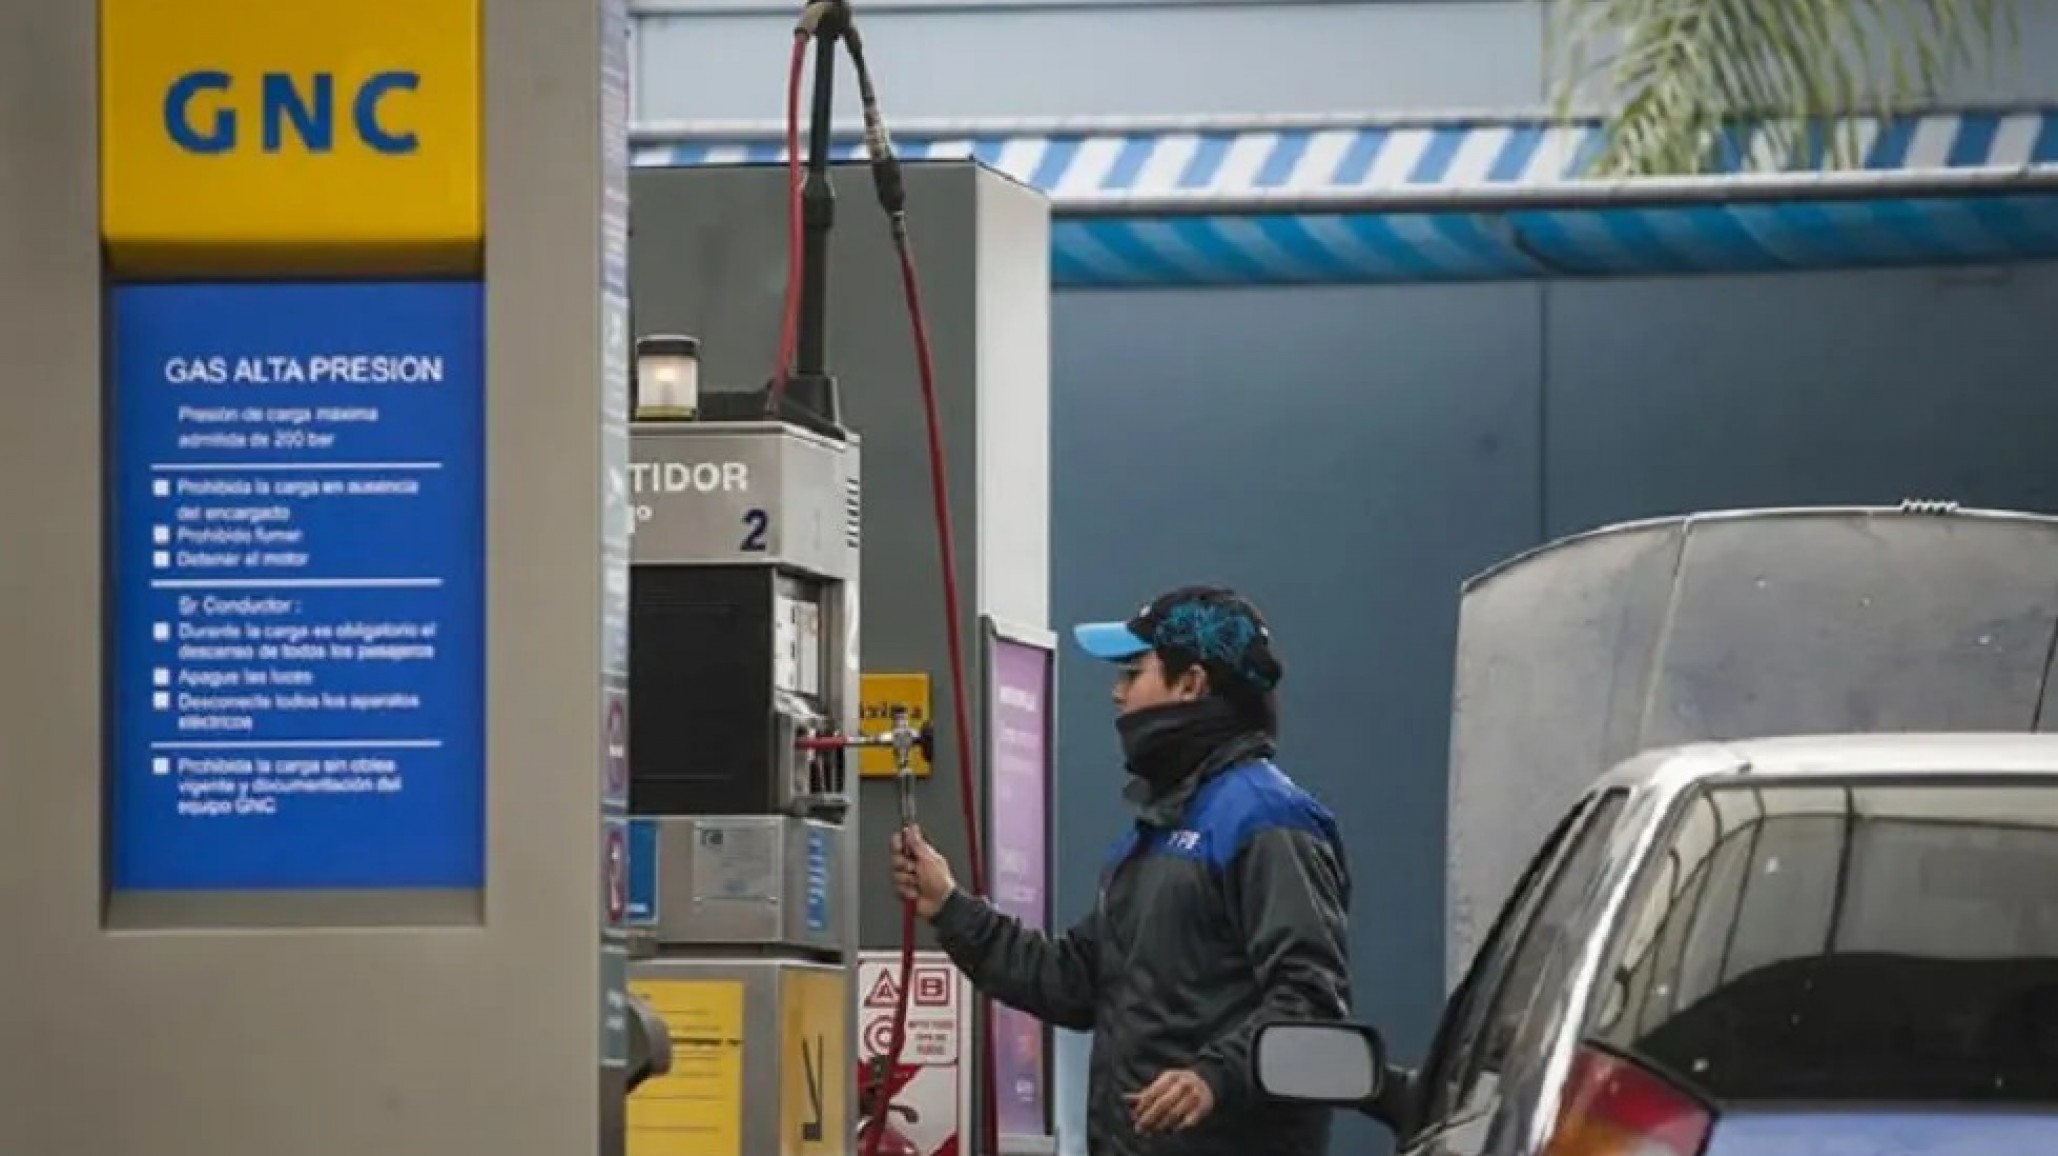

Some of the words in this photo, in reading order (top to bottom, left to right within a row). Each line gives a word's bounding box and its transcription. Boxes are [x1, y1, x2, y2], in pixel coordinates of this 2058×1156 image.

[163, 71, 421, 154] GNC
[165, 357, 228, 384] GAS
[234, 357, 304, 383] ALTA
[308, 355, 443, 383] PRESION
[242, 406, 264, 422] de
[267, 407, 312, 425] carga
[249, 431, 270, 447] de
[256, 479, 271, 495] la
[274, 481, 320, 498] carga
[322, 482, 344, 495] en
[176, 505, 202, 522] del
[739, 508, 770, 552] 2
[262, 552, 309, 566] motor
[203, 595, 293, 614] Conductor
[178, 623, 242, 640] Durante
[245, 623, 262, 639] la
[264, 625, 309, 643] carga
[312, 626, 333, 639] es
[335, 622, 419, 643] obligatorio
[419, 622, 437, 638] el
[258, 644, 279, 660] de
[281, 644, 327, 660] todos
[329, 644, 354, 660] los
[178, 669, 240, 687] Apague
[243, 669, 268, 686] las
[269, 669, 313, 686] luces
[274, 692, 320, 708] todos
[321, 692, 347, 708] los
[349, 694, 420, 711] aparatos
[256, 758, 271, 774] la
[274, 759, 321, 777] carga
[239, 779, 251, 800] y
[376, 776, 403, 795] del
[234, 796, 278, 814] GNC
[920, 978, 944, 997] B
